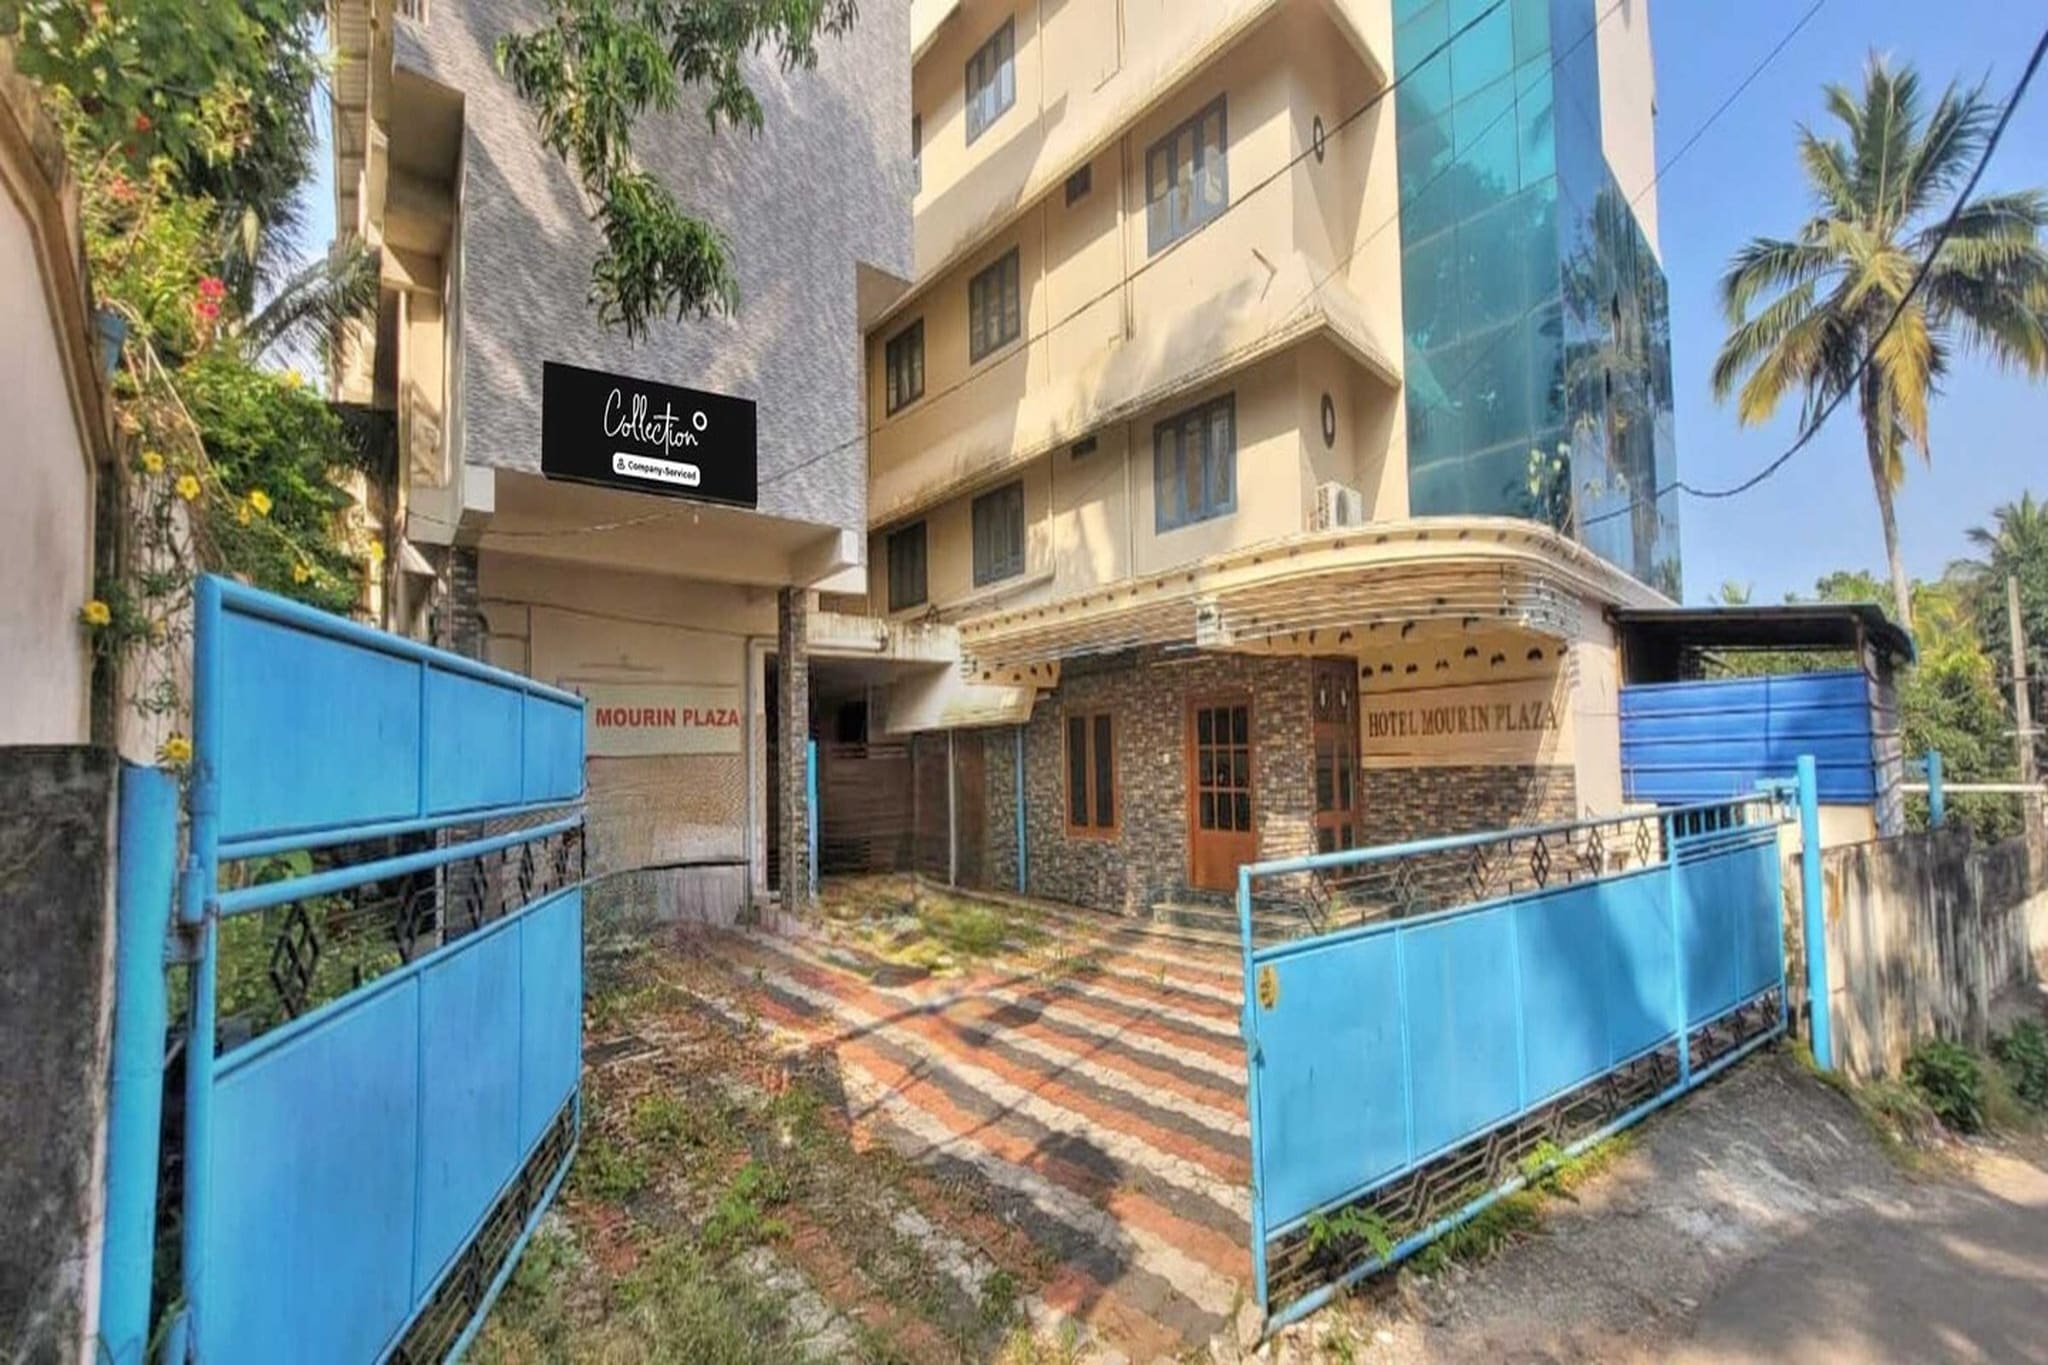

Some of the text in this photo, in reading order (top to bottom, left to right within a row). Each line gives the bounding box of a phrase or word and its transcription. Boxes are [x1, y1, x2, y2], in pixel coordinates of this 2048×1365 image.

[604, 388, 698, 456] Collection
[596, 708, 740, 727] MOURIN PLAZA
[1368, 702, 1559, 738] HOTEL MOURIN PLAZA
